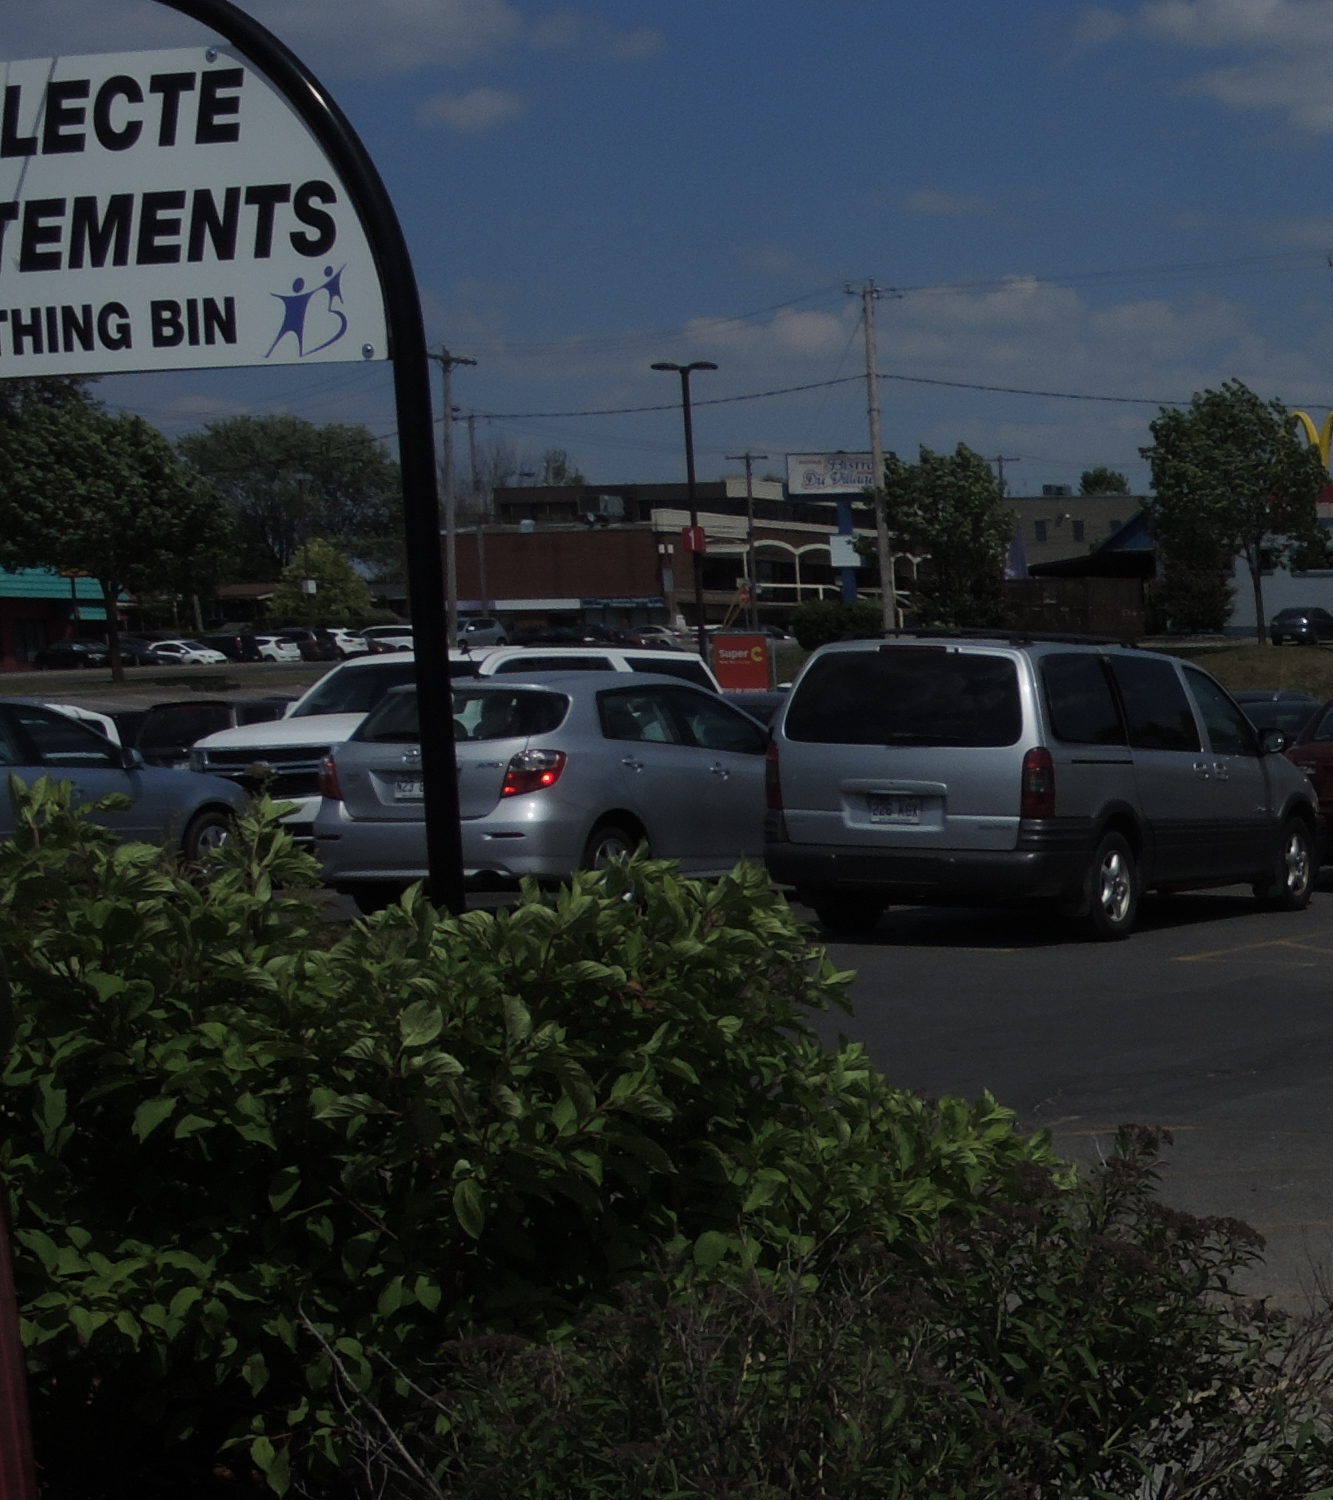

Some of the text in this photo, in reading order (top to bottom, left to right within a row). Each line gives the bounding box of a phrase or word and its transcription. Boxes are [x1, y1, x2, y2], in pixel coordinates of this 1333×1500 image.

[0, 68, 244, 158] LECTE
[0, 296, 237, 355] HING BIN
[688, 529, 696, 551] 1
